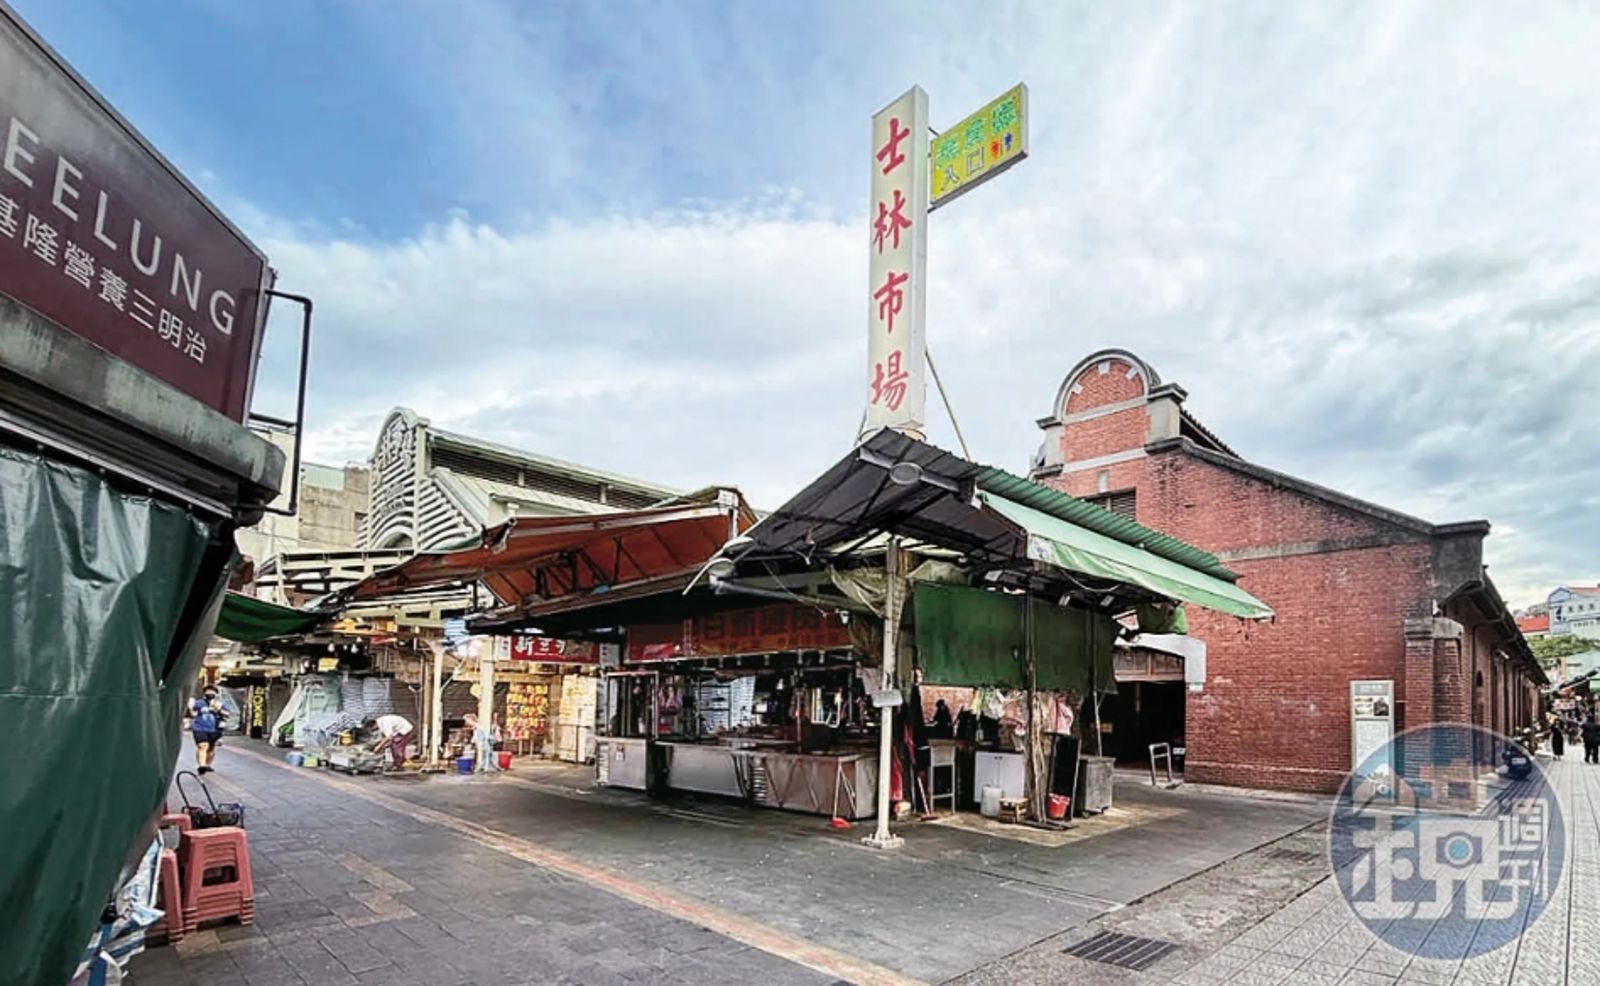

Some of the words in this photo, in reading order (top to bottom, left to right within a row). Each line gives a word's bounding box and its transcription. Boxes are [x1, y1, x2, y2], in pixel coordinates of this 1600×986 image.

[940, 146, 985, 191] 入口
[871, 118, 912, 411] 士林市場
